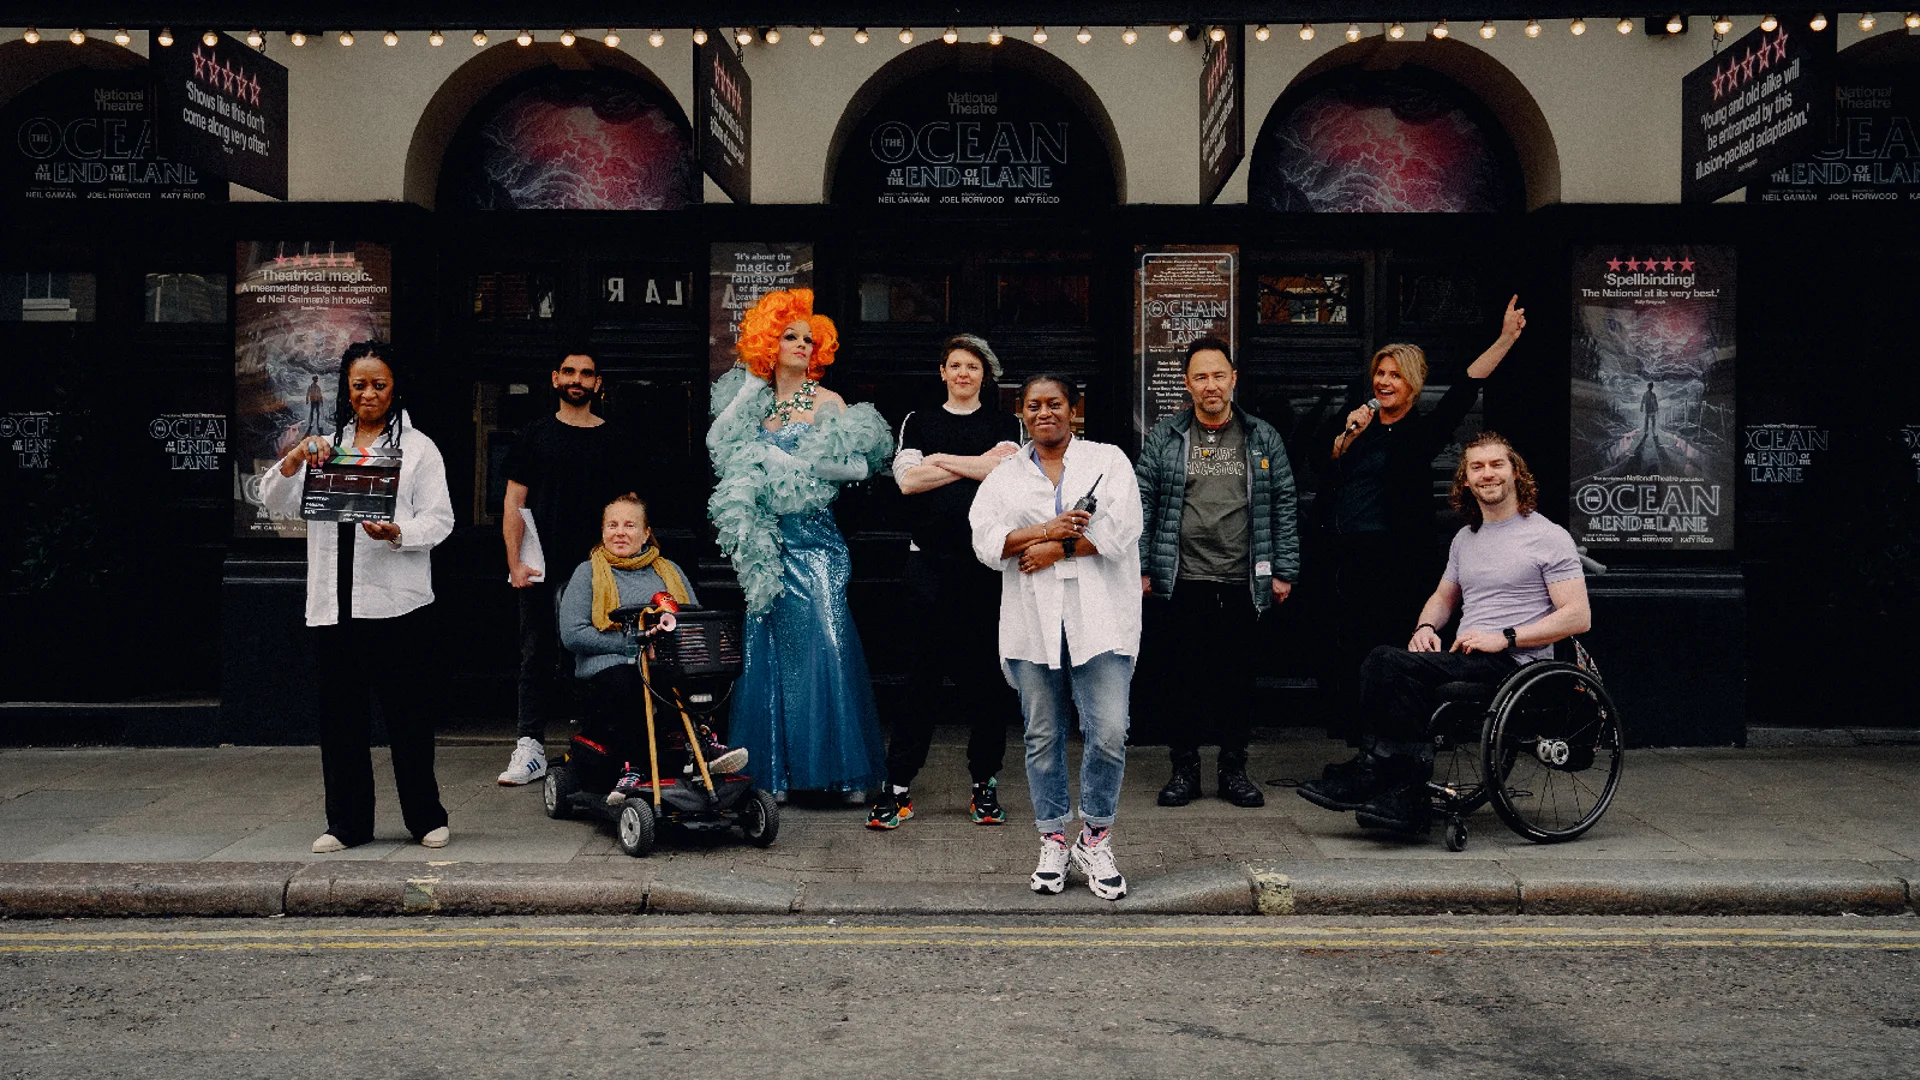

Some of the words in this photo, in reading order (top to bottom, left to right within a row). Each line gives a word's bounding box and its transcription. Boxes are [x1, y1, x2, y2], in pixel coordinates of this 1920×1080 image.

[1728, 91, 1745, 117] and
[1746, 81, 1760, 106] old
[1761, 72, 1782, 98] alike
[1784, 57, 1800, 84] will
[1837, 86, 1892, 98] National
[94, 88, 143, 100] National
[948, 92, 998, 103] National
[96, 100, 143, 111] Theatre
[216, 95, 230, 117] like
[231, 103, 246, 124] this
[948, 102, 998, 115] Theatre
[1839, 98, 1892, 109] Theatre
[1708, 133, 1718, 152] be
[1719, 104, 1761, 145] entranced
[1762, 102, 1774, 123] by
[1775, 89, 1793, 114] this
[183, 108, 206, 130] come
[208, 116, 230, 144] along
[231, 128, 247, 151] very
[31, 133, 49, 142] THE
[870, 120, 1069, 164] OCEAN
[885, 138, 903, 147] THE
[34, 172, 51, 181] THE
[53, 162, 108, 184] END
[37, 164, 50, 173] AT
[109, 173, 128, 181] THE
[128, 162, 198, 185] LANE
[112, 164, 125, 173] OF
[889, 168, 902, 177] AT
[964, 168, 979, 177] OF
[1771, 173, 1790, 183] THE
[1792, 162, 1851, 184] END
[1855, 165, 1870, 174] OF
[886, 177, 905, 186] THE
[905, 166, 961, 188] END
[962, 177, 980, 186] THE
[981, 166, 1053, 188] LANE
[1852, 173, 1872, 182] THE
[1762, 194, 1781, 202] NEIL
[1828, 193, 1850, 201] JOEL
[751, 252, 776, 260] about
[777, 252, 791, 260] the
[735, 262, 773, 274] magic
[777, 262, 791, 272] of
[329, 270, 373, 284] magic.
[731, 274, 777, 286] fantasy
[241, 284, 249, 292] A
[250, 284, 309, 294] mesmerising
[311, 284, 336, 294] stage
[338, 284, 388, 294] adaptation
[1581, 289, 1600, 297] The
[1602, 289, 1642, 297] National
[1644, 289, 1654, 297] at
[1656, 289, 1668, 297] its
[1670, 290, 1692, 299] very
[257, 295, 267, 304] of
[268, 295, 286, 304] Neil
[287, 295, 329, 304] Gaiman's
[332, 296, 344, 304] hit
[1148, 300, 1228, 318] OCEAN
[1171, 318, 1204, 331] END
[149, 418, 227, 440] OCEA
[1745, 429, 1830, 450] CEAN
[176, 440, 215, 455] END
[171, 455, 220, 470] LANE
[1757, 451, 1798, 466] END
[1751, 467, 1804, 483] LANE
[1576, 484, 1720, 516] OCEAN
[1602, 516, 1643, 532] END
[1656, 516, 1709, 532] LANE
